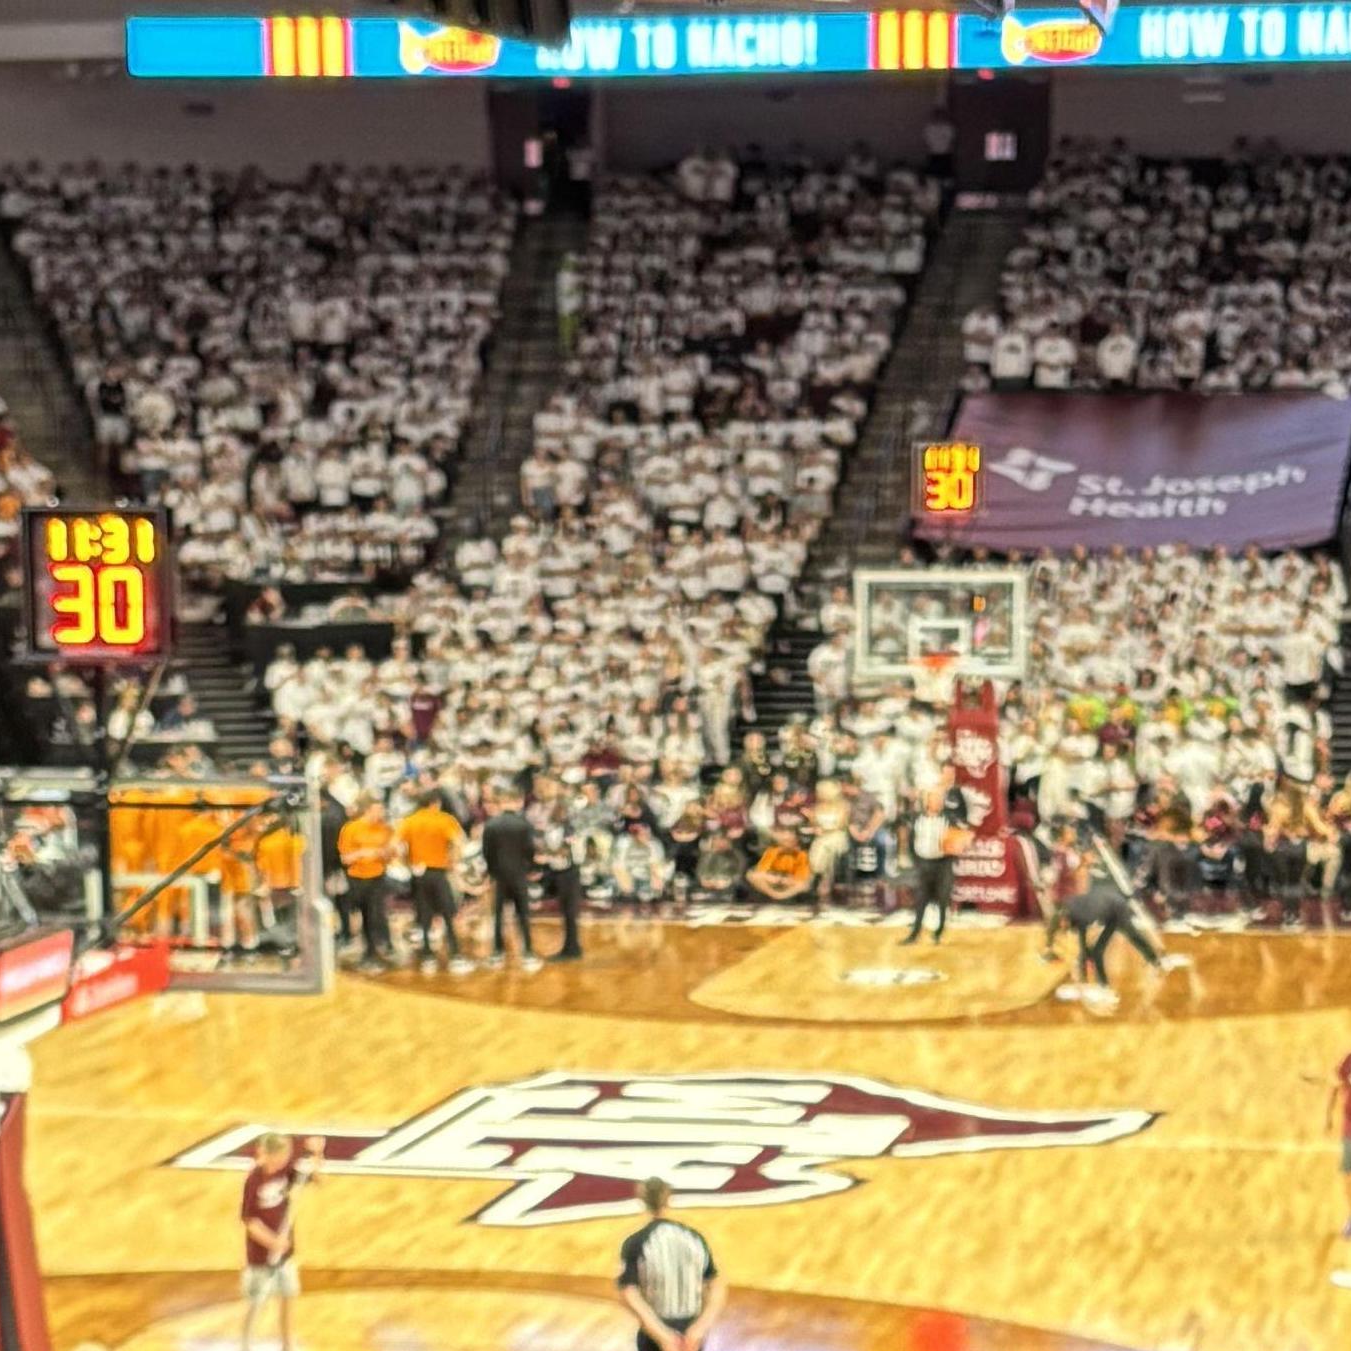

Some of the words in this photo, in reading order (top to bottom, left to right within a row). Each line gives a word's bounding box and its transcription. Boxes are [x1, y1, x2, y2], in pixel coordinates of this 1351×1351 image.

[632, 23, 676, 68] TO
[687, 20, 817, 67] NACHO!
[1140, 9, 1228, 57] HOW
[1243, 9, 1286, 56] TO
[925, 471, 974, 510] 30
[1075, 473, 1135, 497] St.
[1143, 464, 1307, 497] Joseph
[1068, 496, 1228, 519] Health
[52, 565, 144, 645] 30
